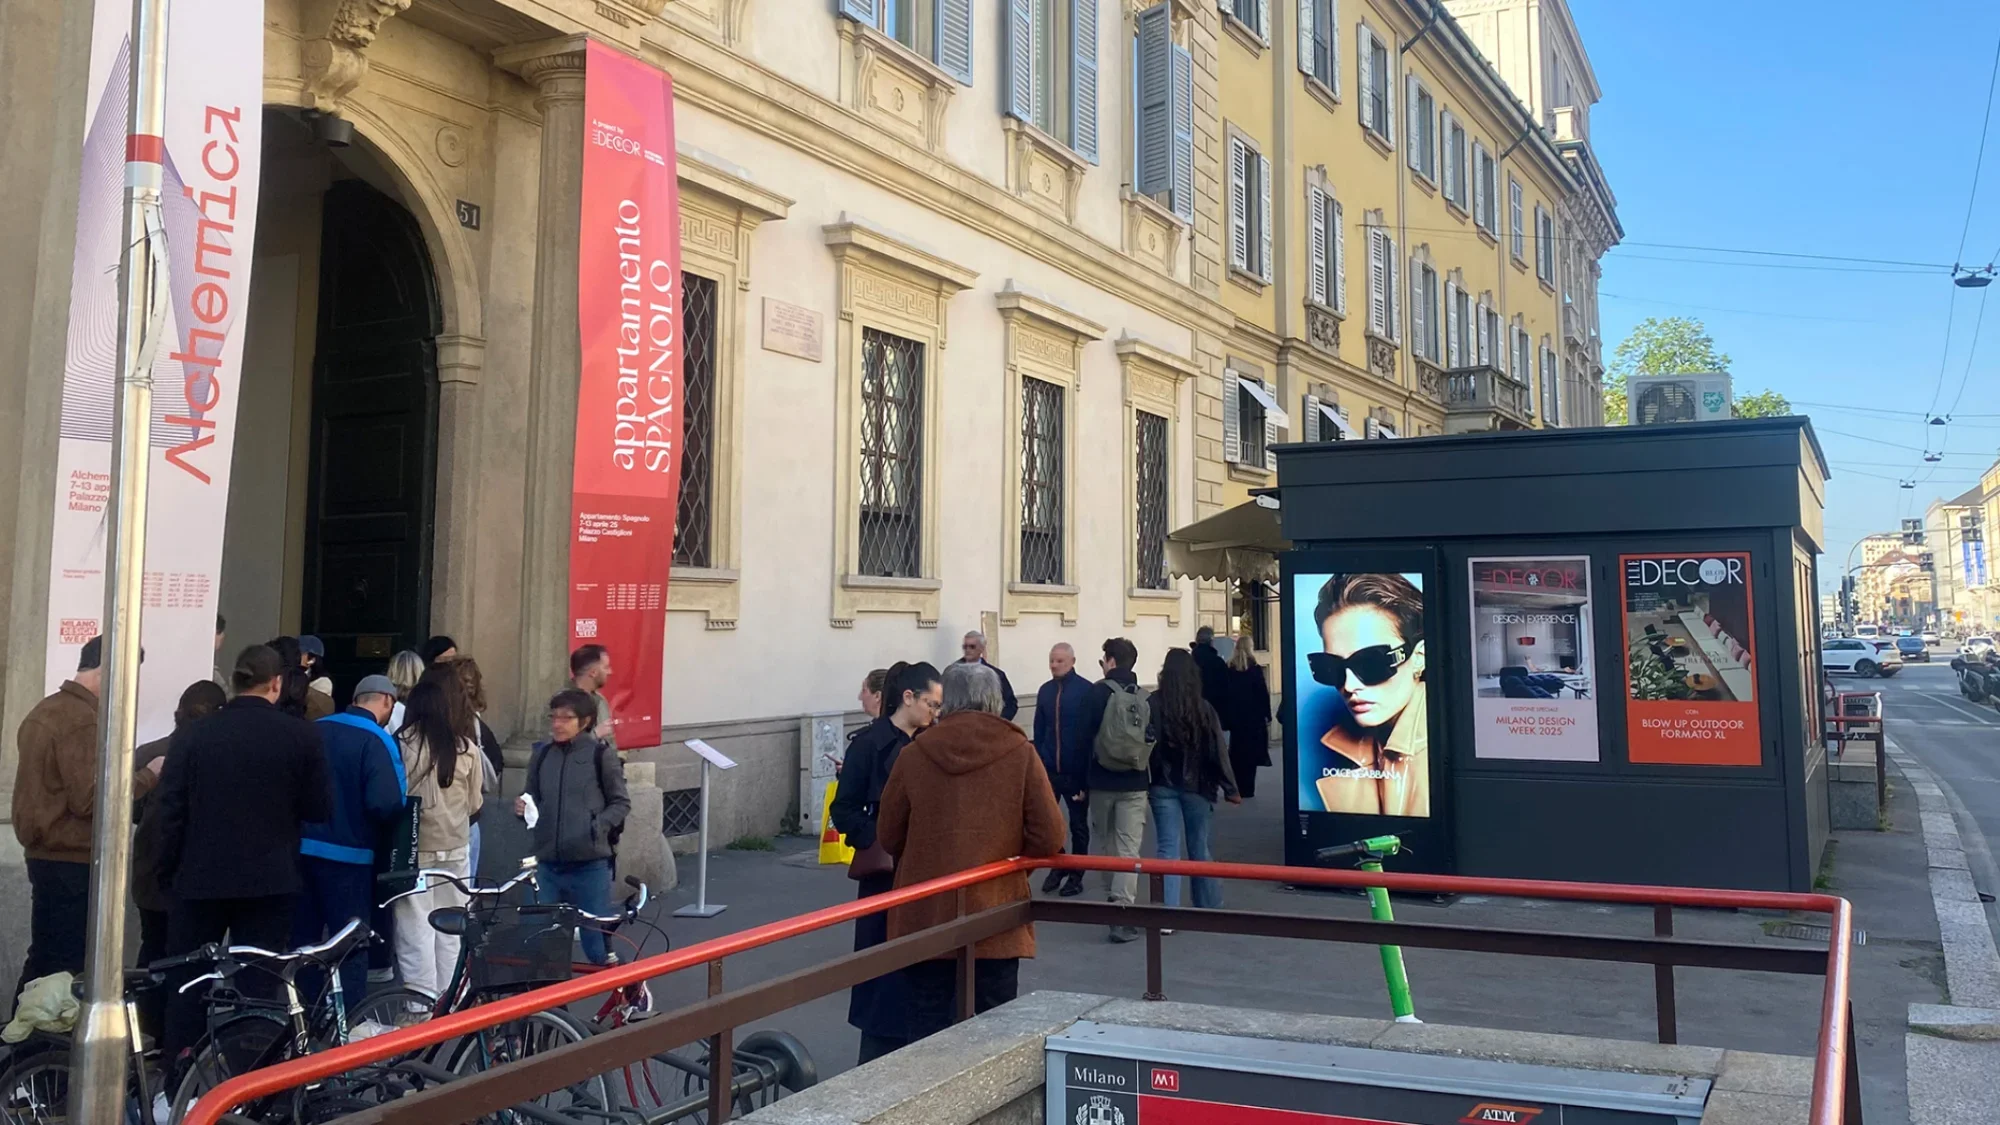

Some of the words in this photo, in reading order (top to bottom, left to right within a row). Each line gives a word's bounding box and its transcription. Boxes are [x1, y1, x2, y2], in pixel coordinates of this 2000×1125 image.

[597, 130, 641, 157] DECOR
[460, 204, 477, 226] 51
[612, 199, 646, 471] appartamento
[645, 259, 674, 473] SPAGNOLO
[71, 470, 110, 481] Alchem
[69, 491, 108, 502] Palazzo
[68, 501, 102, 513] Milano
[579, 512, 621, 521] Appartamento
[622, 514, 650, 523] Spagnolo
[592, 521, 609, 529] aprile
[579, 527, 601, 535] Palazzo
[601, 528, 633, 537] Castiglioni
[578, 535, 598, 543] Milano
[1627, 560, 1641, 586] ELLE
[1641, 557, 1744, 586] DECOR
[1492, 614, 1525, 625] DESIGN
[1527, 614, 1575, 625] EXPERIENCE
[1495, 716, 1536, 725] MILANO
[1538, 717, 1576, 726] DESIGN
[1642, 719, 1672, 728] BLOW
[1674, 719, 1688, 729] UP
[1690, 720, 1745, 730] OUTDOOR
[1508, 726, 1536, 735] WEEK
[1539, 727, 1563, 736] 2025
[1661, 730, 1712, 739] FORMATO
[1714, 731, 1726, 740] XL
[408, 846, 418, 864] Rug
[1074, 1066, 1126, 1087] Milano
[1154, 1073, 1175, 1087] M1
[1481, 1108, 1516, 1123] ATM
